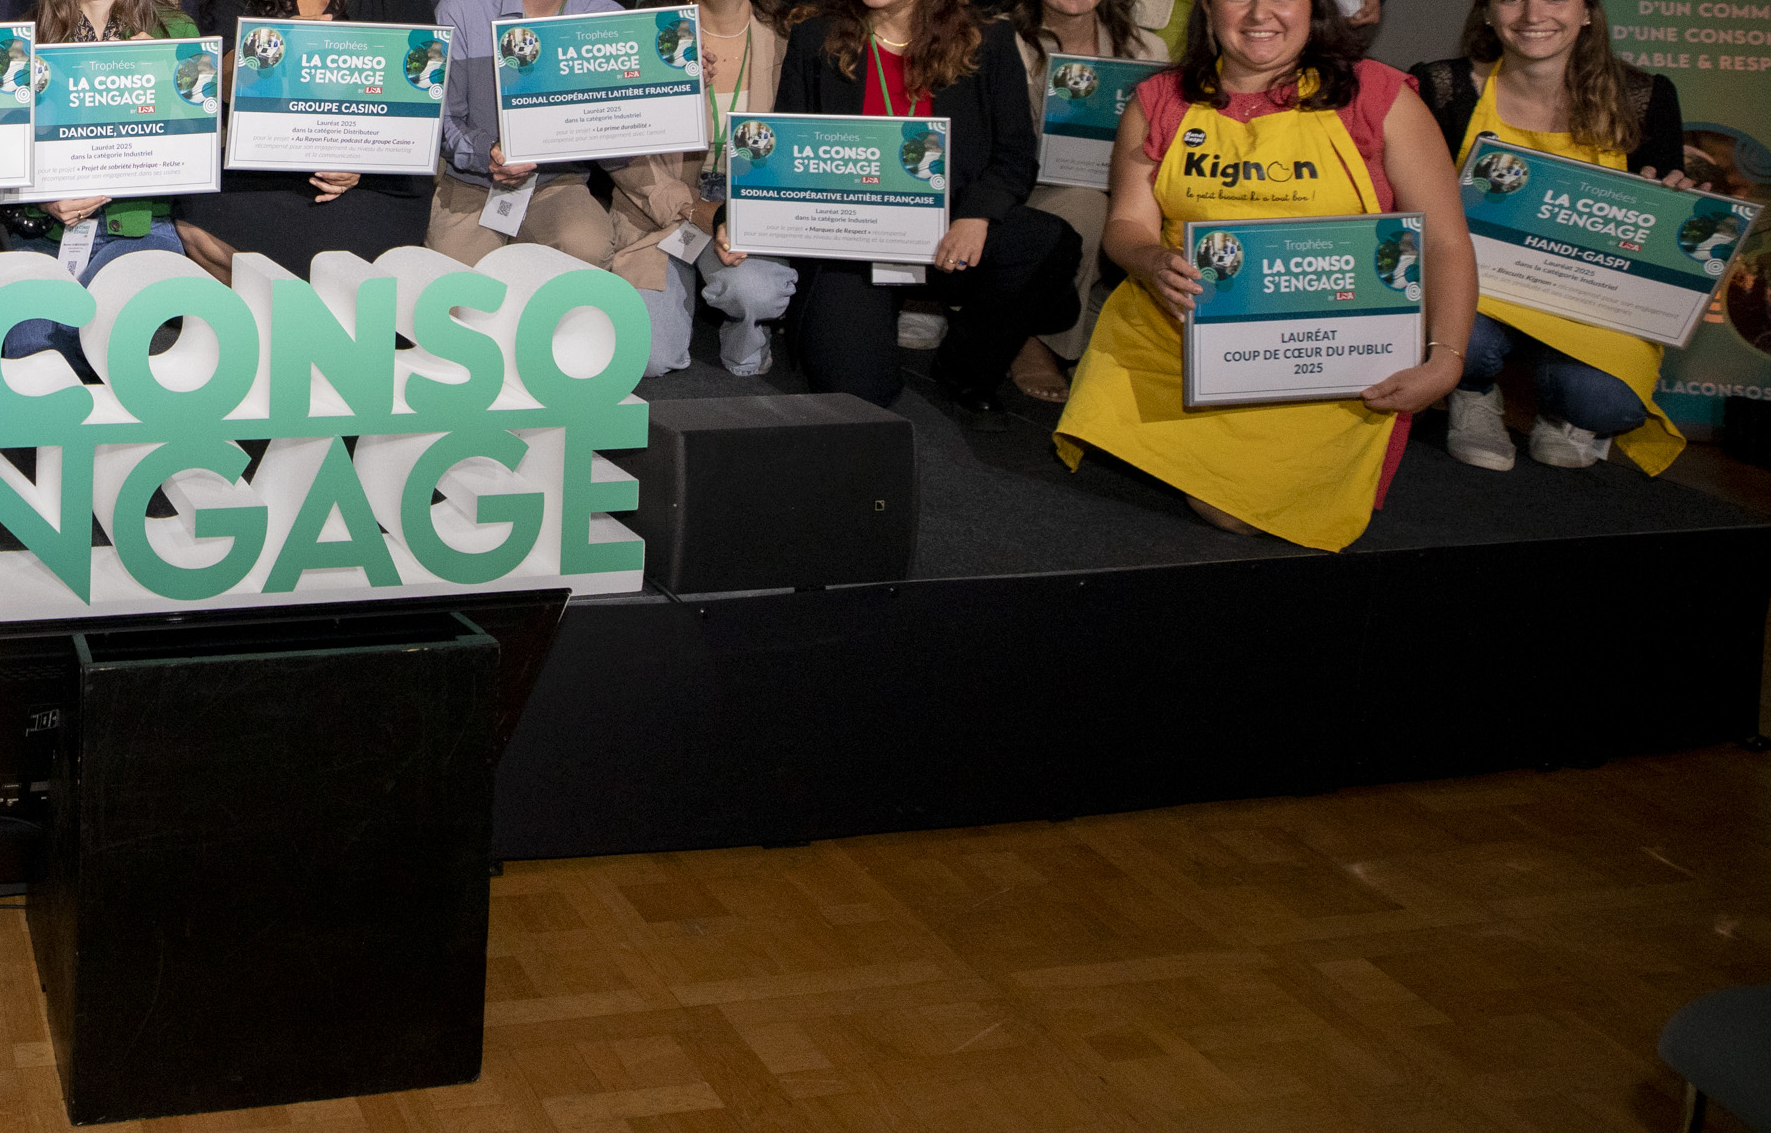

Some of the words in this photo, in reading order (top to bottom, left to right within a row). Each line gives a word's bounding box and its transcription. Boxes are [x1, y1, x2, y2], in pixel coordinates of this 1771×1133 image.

[1639, 0, 1691, 16] D'UN
[1613, 25, 1678, 41] D'UNE
[1685, 28, 1771, 45] CONSO
[558, 47, 577, 60] LA
[581, 41, 639, 57] CONSO
[301, 54, 322, 67] LA
[327, 55, 385, 69] CONSO
[560, 56, 640, 75] S'ENGAGE
[69, 77, 89, 91] LA
[94, 74, 155, 89] CONSO
[301, 69, 384, 85] S'ENGAGE
[69, 90, 155, 107] S'ENGAGE
[512, 96, 548, 105] SODIAAL
[550, 91, 607, 103] COOPÉRATIVE
[608, 87, 644, 98] LAITIÈRE
[645, 85, 691, 95] FRANÇAISE
[289, 101, 338, 112] GROUPE
[342, 103, 388, 114] CASINO
[59, 126, 117, 138] DANONE,
[119, 123, 164, 134] VOLVIC
[793, 145, 814, 158] LA
[818, 146, 880, 160] CONSO
[793, 160, 880, 175] S'ENGAGE
[1184, 152, 1318, 188] Kignon
[740, 189, 779, 197] SODIAAL
[780, 190, 842, 200] COOPÉRATIVE
[844, 192, 882, 202] LAITIÈRE
[884, 195, 934, 205] FRANÇAISE
[1543, 189, 1570, 208] LA
[1577, 198, 1656, 228] CONSO
[1537, 205, 1651, 244] S'ENGAGE
[1524, 236, 1630, 271] HANDI-GASPI
[1262, 258, 1286, 274] LA
[1290, 255, 1356, 272] CONSO
[1263, 273, 1356, 294] S'ENGAGE
[1282, 328, 1338, 344] LAURÉAT
[1224, 350, 1260, 362] COUP
[1264, 349, 1280, 360] DE
[1326, 346, 1346, 357] DU
[1349, 343, 1393, 356] PUBLIC
[1294, 363, 1323, 374] 2025
[1658, 379, 1771, 400] LACONSOS
